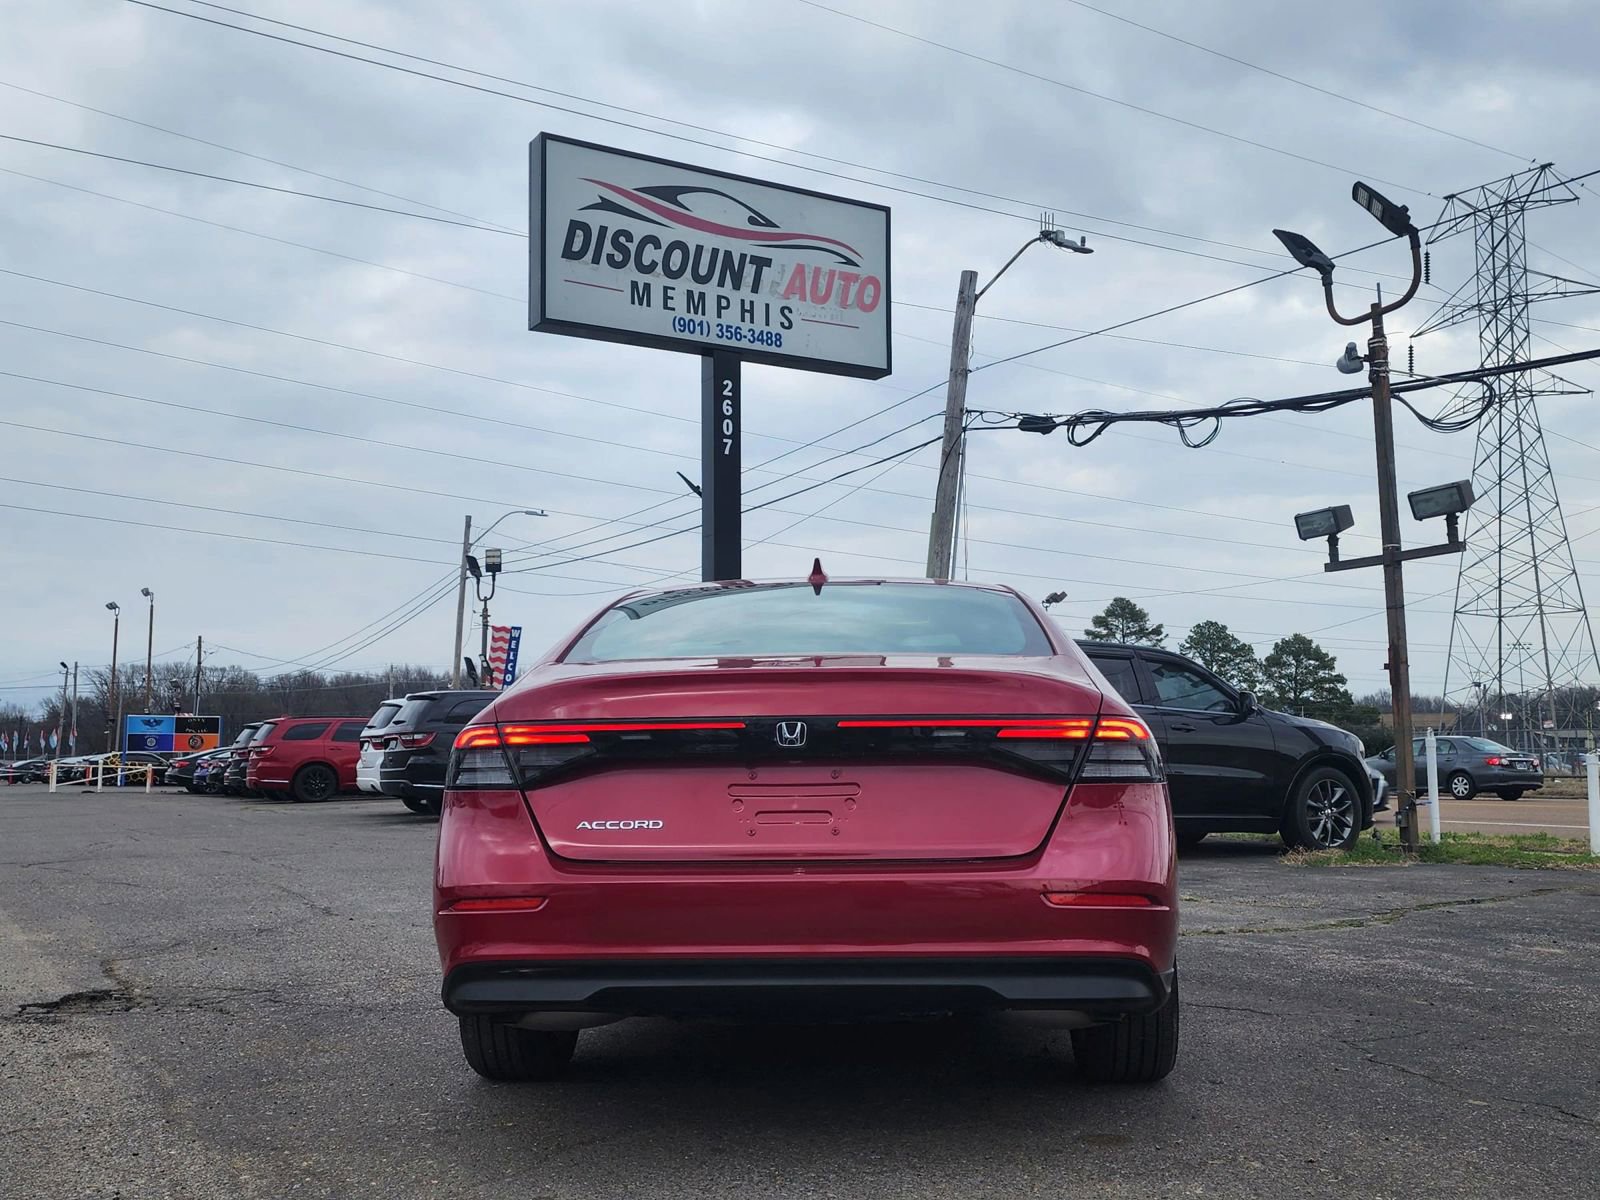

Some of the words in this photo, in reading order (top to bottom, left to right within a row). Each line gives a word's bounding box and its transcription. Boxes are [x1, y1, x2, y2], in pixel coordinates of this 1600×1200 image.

[561, 219, 772, 294] DISCOUNT
[783, 262, 882, 313] AUTO
[630, 280, 794, 330] MEMPHIS
[672, 316, 711, 338] (901)
[716, 323, 783, 348] 356-3488
[722, 379, 733, 455] 2607
[505, 629, 521, 687] WELCO
[576, 820, 663, 830] ACCORD
